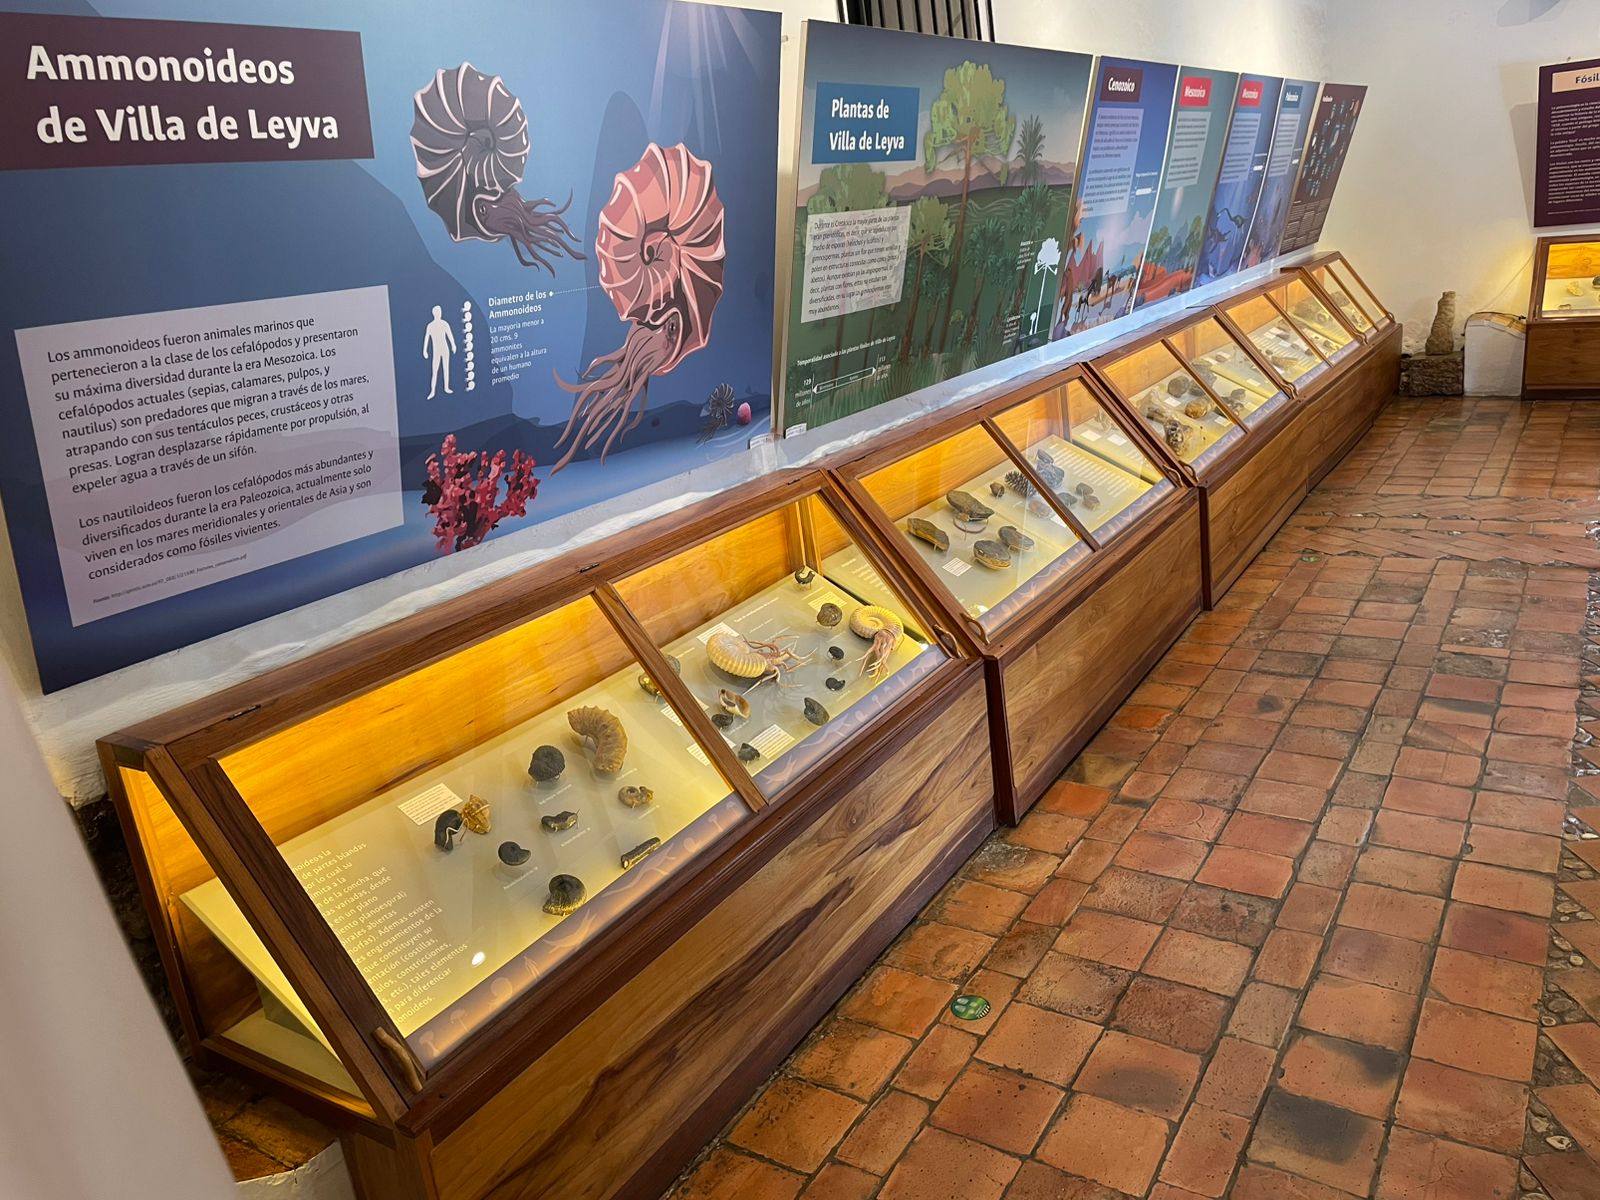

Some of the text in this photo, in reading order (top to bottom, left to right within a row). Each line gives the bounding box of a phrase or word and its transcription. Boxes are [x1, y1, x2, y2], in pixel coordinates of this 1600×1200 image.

[27, 45, 295, 85] Ammonoideos
[1108, 77, 1136, 92] Cenozoico
[832, 97, 890, 119] Plantas de
[37, 106, 339, 150] de Villa de Leyva
[830, 130, 905, 156] Villa de Leyva
[489, 290, 547, 307] Diametro de los
[489, 304, 542, 319] Ammonoideos
[47, 318, 314, 362] Los ammonoideos fueron animales marinos que
[490, 326, 497, 334] La
[522, 320, 540, 328] menor
[490, 336, 499, 344] 20
[514, 332, 519, 340] 9
[52, 329, 358, 384] pertenecieron a la clase de los cefalópodos y presentaron
[491, 343, 523, 354] ammonites
[491, 352, 519, 365] equivalen
[525, 349, 530, 358] la
[531, 348, 547, 357] altura
[55, 348, 336, 401] su máxima diversidad durante la era Mesozoica. Los
[492, 361, 532, 375] de un humano
[492, 373, 520, 386] promedio
[59, 366, 329, 419] cefalópodos actuales (sepias, calamares, pulpos, y
[62, 375, 369, 438] nautilus) son predadores que migran a través de los mares,
[66, 393, 353, 457] atrapando con sus tentáculos peces, crustáceos y otras
[69, 403, 369, 478] presas. Logran desplazarse rápidamente por propulsión, al
[72, 446, 256, 493] expeler agua a través de un sifón.
[79, 450, 373, 528] Los nautiloideos fueron los cefalópodos más abundantes y
[82, 464, 371, 545] diversificados durante la era Paleozoica, actualmente solo
[85, 480, 371, 562] viven en los mares meridionales y orientales de Asia y son
[89, 520, 280, 579] considerados como fósiles vivientes.
[313, 858, 337, 874] partes
[336, 843, 366, 860] blandas
[326, 866, 342, 878] cual
[372, 867, 387, 876] que
[369, 876, 391, 890] desde
[356, 896, 377, 911] plano
[367, 910, 396, 930] abiertas
[408, 900, 434, 917] existen
[363, 926, 432, 973] que constituyen su
[366, 919, 424, 956] engrosamientos
[396, 943, 451, 984] constricciones,
[410, 969, 430, 983] tales
[430, 944, 467, 970] elementos
[394, 968, 451, 1011] para diferenciar
